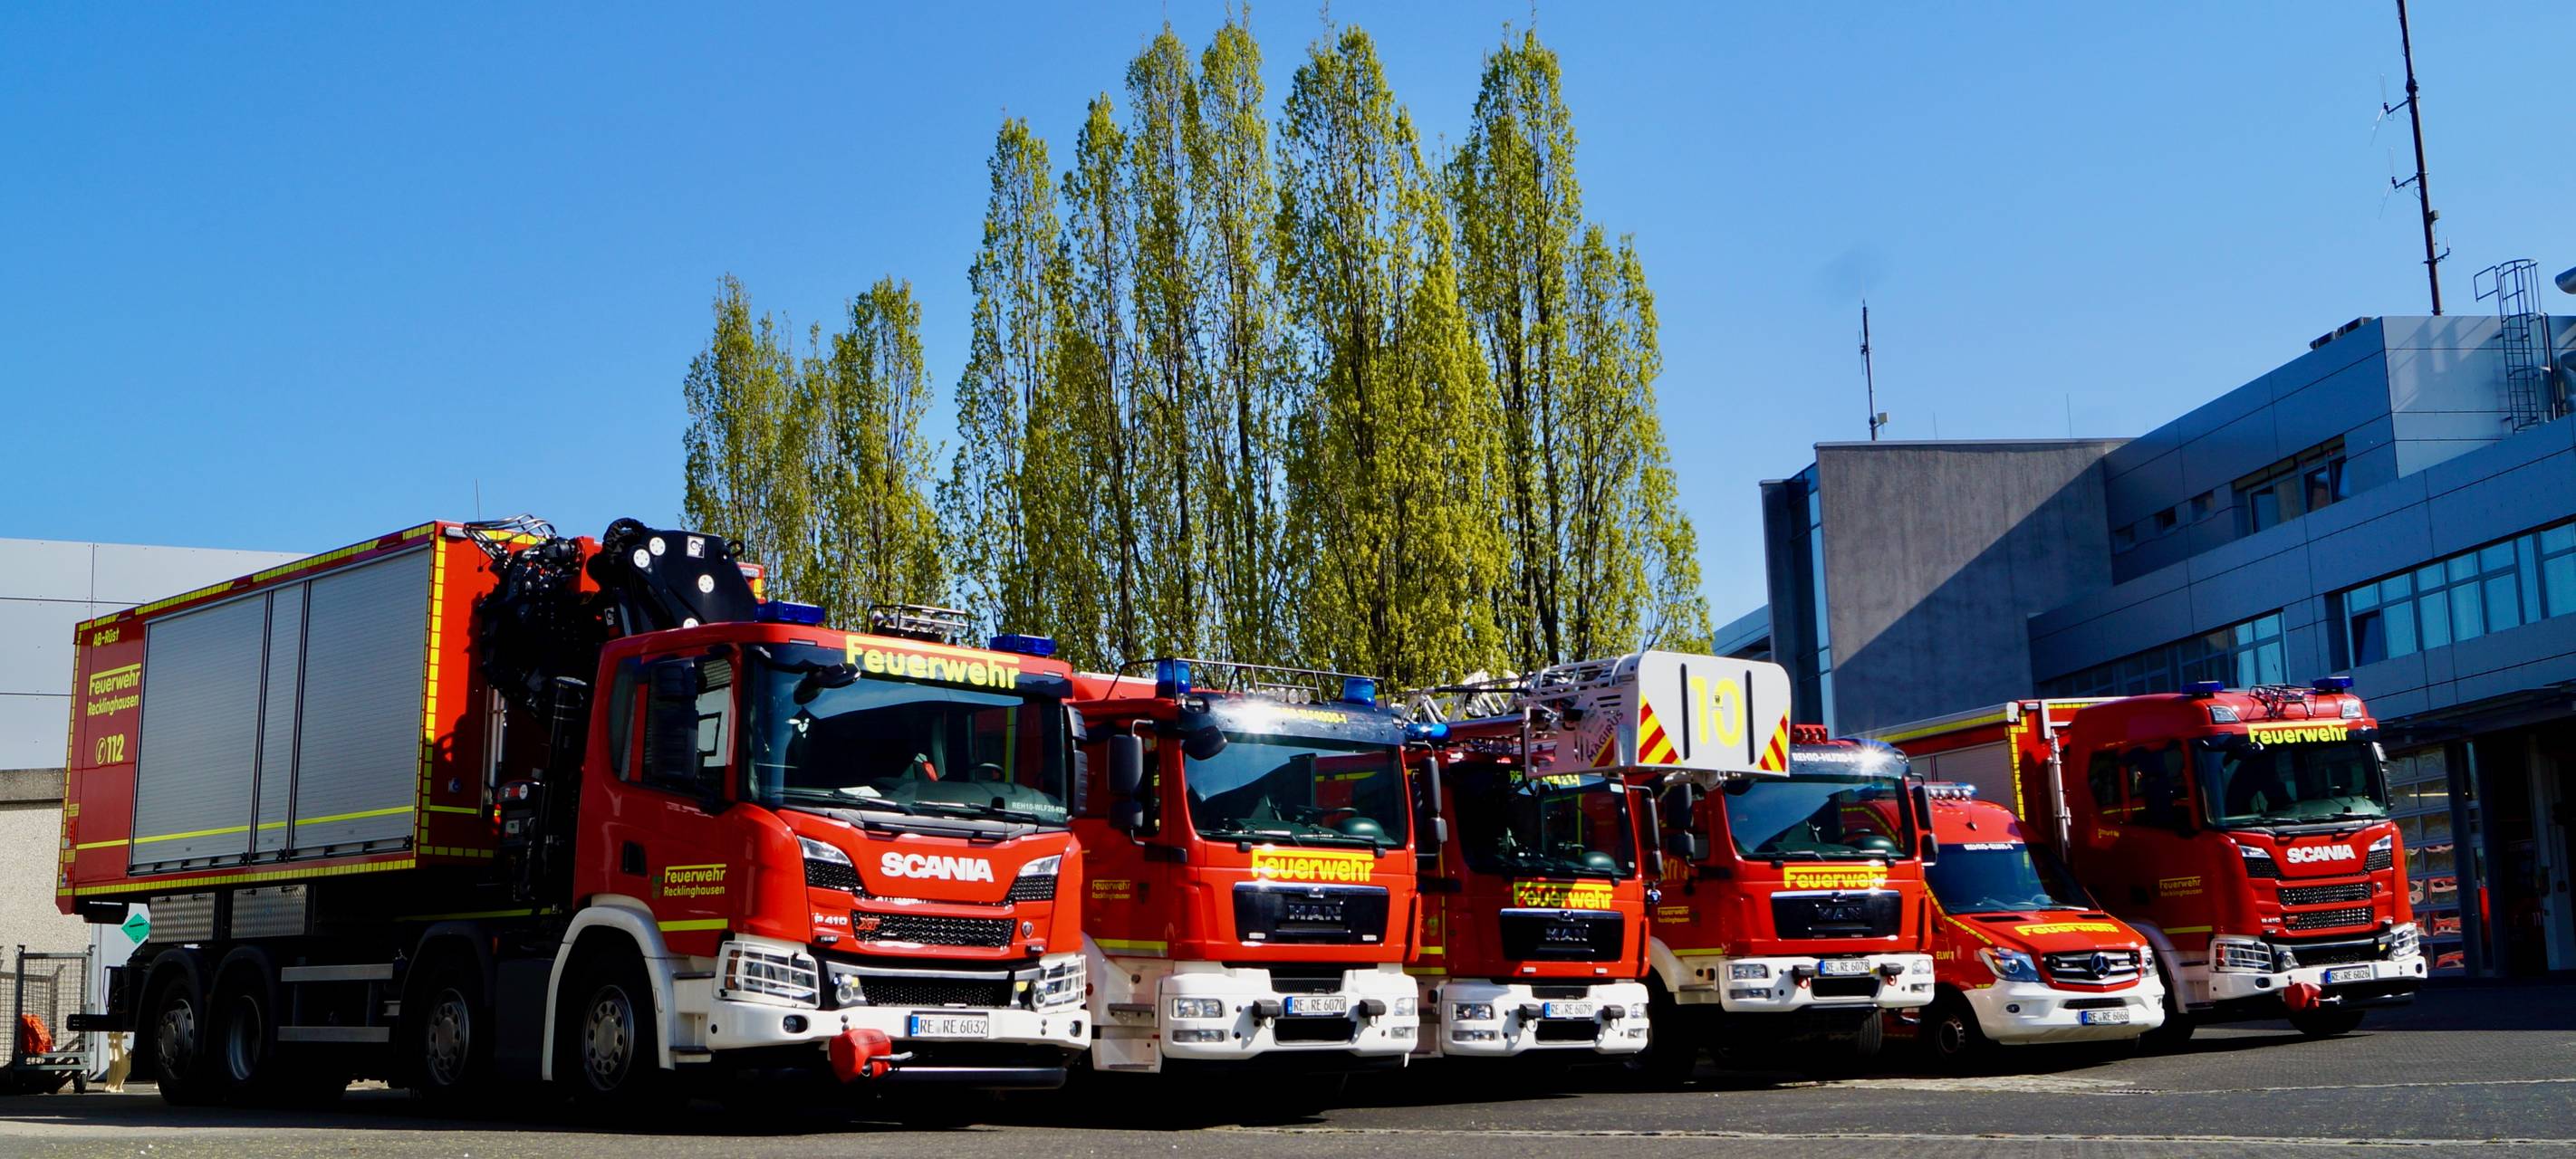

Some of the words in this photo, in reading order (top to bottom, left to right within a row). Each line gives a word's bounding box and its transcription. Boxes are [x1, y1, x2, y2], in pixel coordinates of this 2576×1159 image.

[92, 627, 120, 647] AB-Rüst
[845, 635, 1020, 689] Feuerwehr
[89, 663, 141, 696] Feuerwehr
[87, 694, 139, 717] Recklinghausen
[1690, 675, 1745, 747] 10
[2247, 720, 2348, 745] Feuerwehr
[2287, 845, 2356, 863] SCANIA
[664, 864, 727, 884] Feuerwehr
[880, 852, 995, 882] SCANIA
[1251, 848, 1375, 882] Feuerwehr
[1783, 866, 1888, 888] Feuerwehr
[664, 885, 726, 898] Recklinghausen
[1513, 882, 1613, 909] Feuerwehr
[824, 915, 848, 925] 410
[1288, 905, 1341, 921] MAN
[1545, 927, 1588, 942] MAN
[2014, 923, 2119, 935] Feuerwehr
[1293, 999, 1304, 1011] RE
[1311, 999, 1322, 1011] RE
[1323, 999, 1345, 1011] 6070
[920, 1019, 934, 1034] RE
[943, 1020, 957, 1034] RE
[960, 1020, 986, 1035] 6032
